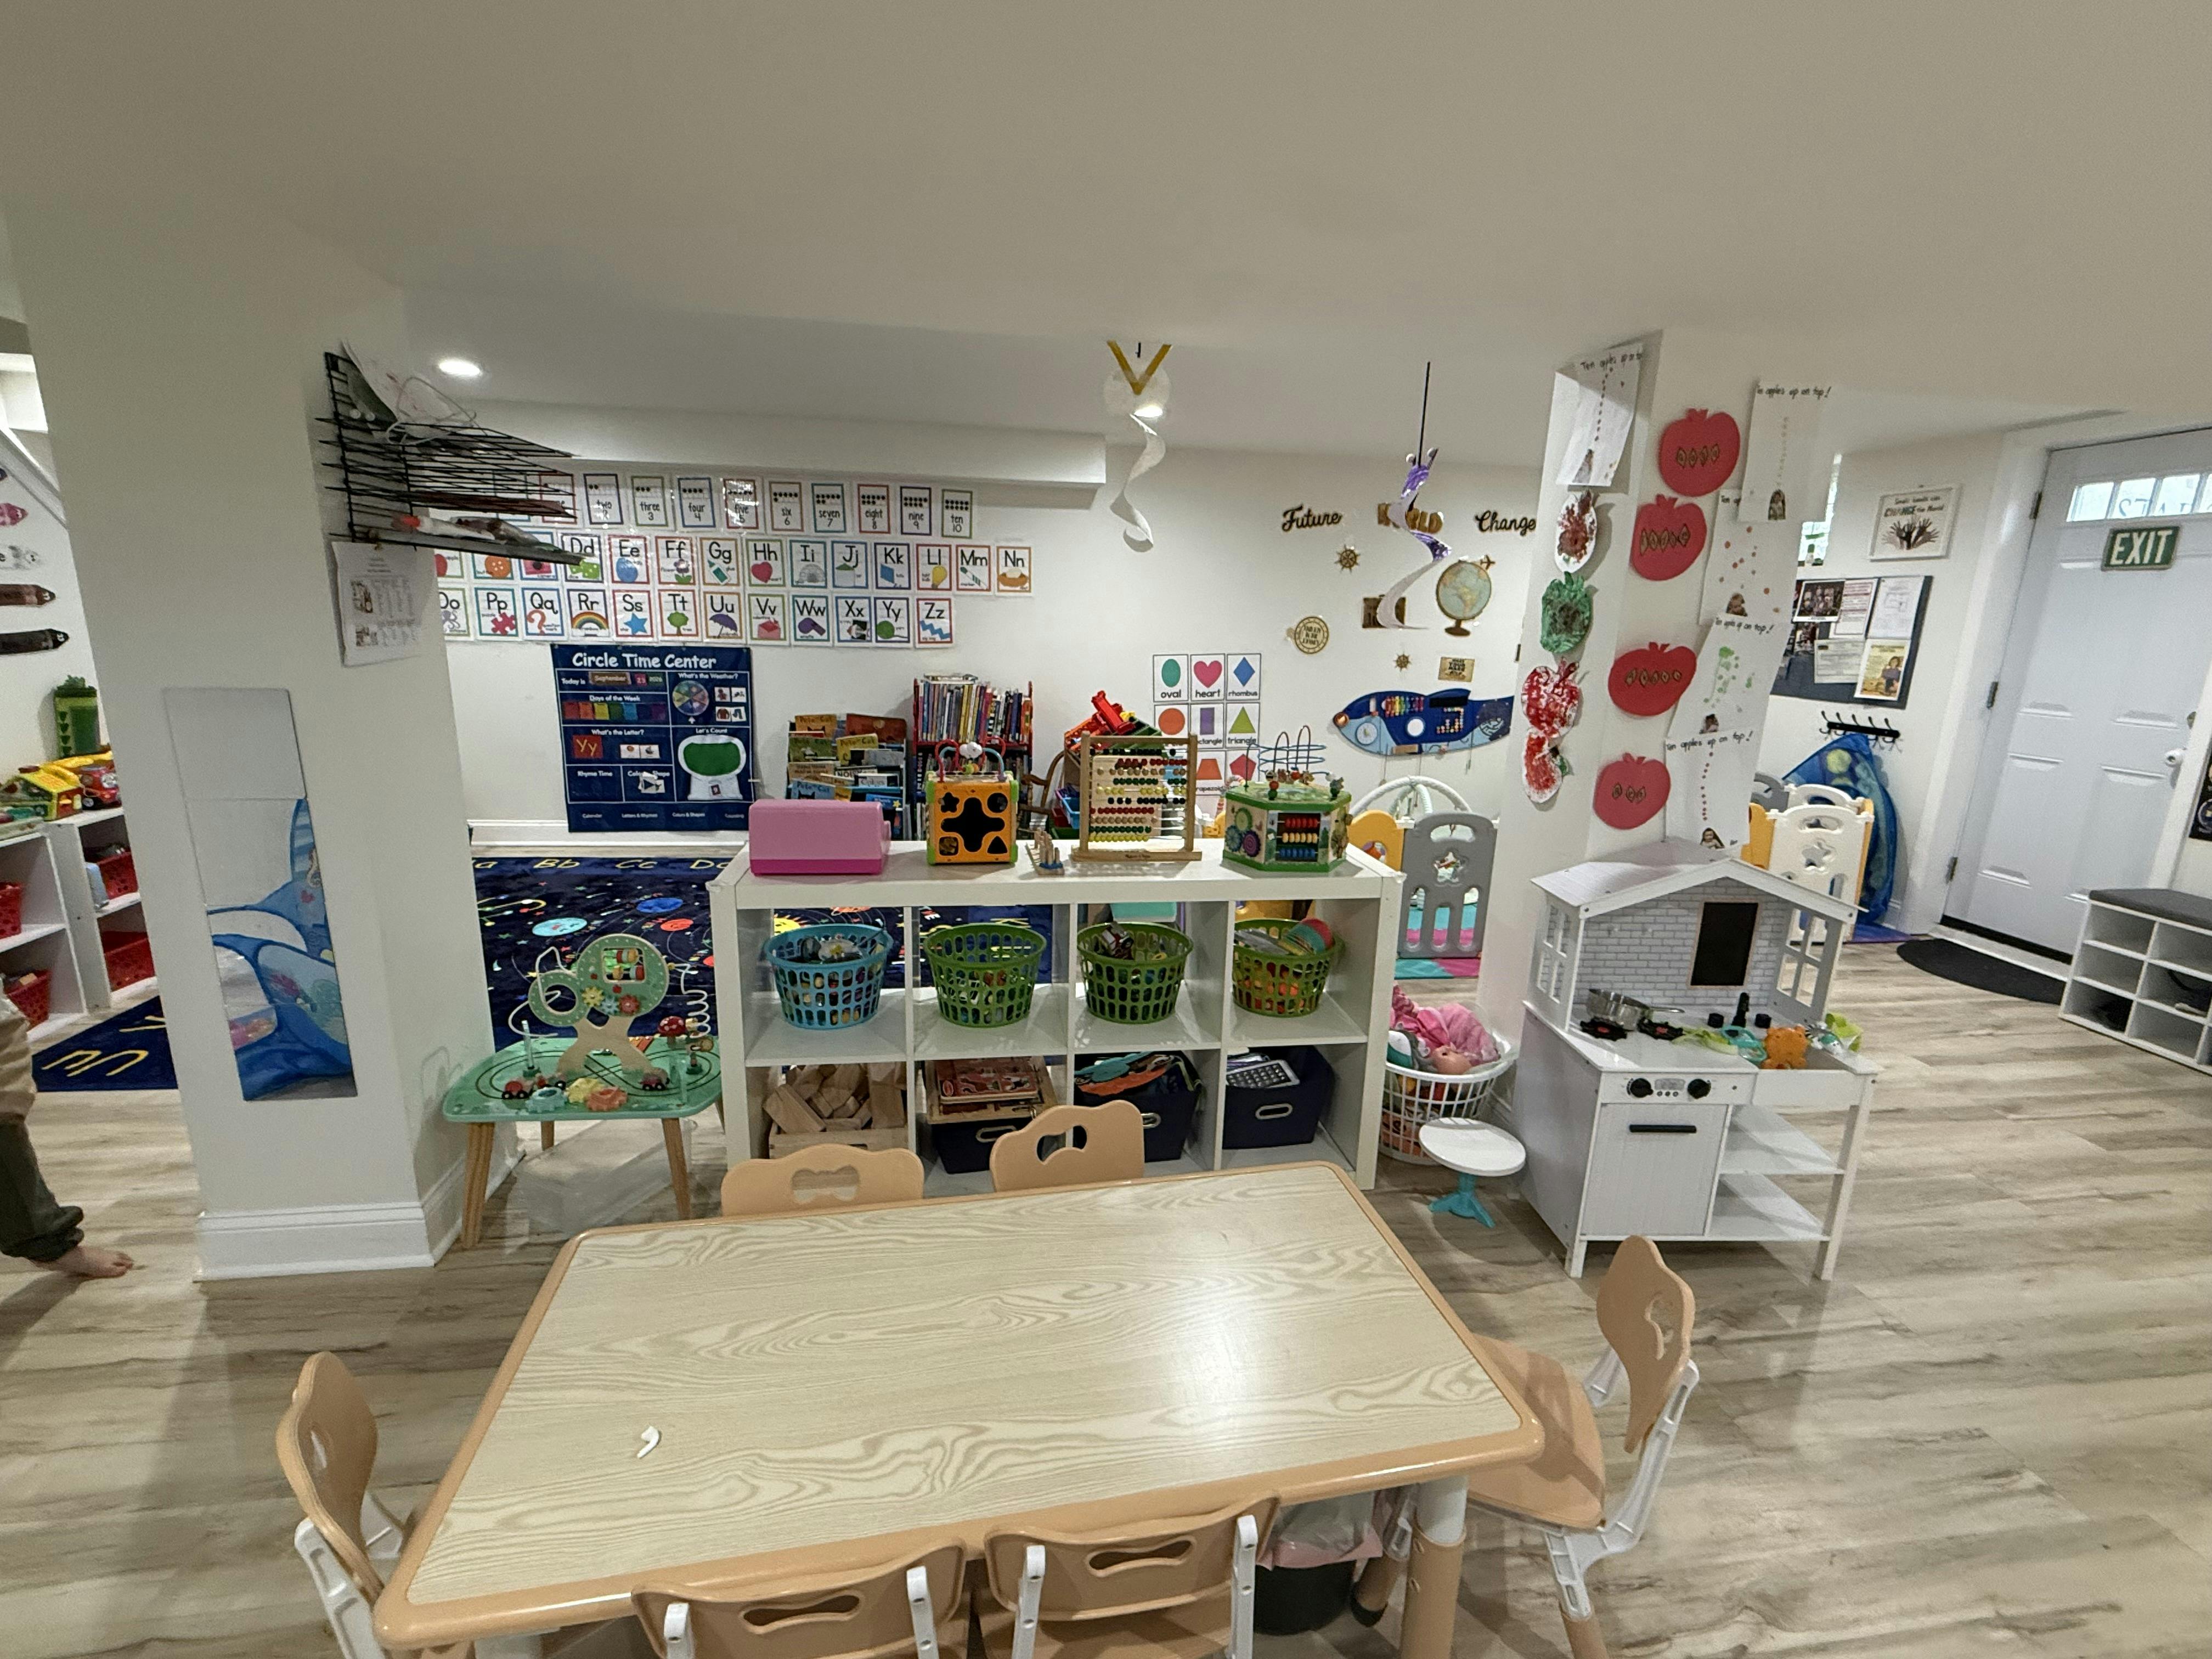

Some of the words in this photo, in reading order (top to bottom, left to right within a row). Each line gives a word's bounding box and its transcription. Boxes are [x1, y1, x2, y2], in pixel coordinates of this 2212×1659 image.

[640, 501, 661, 511] three
[688, 502, 705, 512] four
[734, 504, 749, 515] five
[781, 506, 792, 517] six
[819, 509, 840, 518] seven
[865, 509, 883, 521] eight
[648, 512, 654, 521] 3
[695, 514, 702, 522] 4
[740, 515, 746, 523] 5
[784, 517, 791, 526] 6
[827, 518, 833, 527] 7
[872, 521, 877, 530] 8
[909, 512, 924, 521] nine
[913, 521, 919, 530] 9
[950, 514, 963, 524] ten
[1282, 503, 1344, 532] Future
[1475, 509, 1536, 537] Change
[952, 524, 962, 533] 10
[571, 537, 594, 555] Dd
[619, 539, 641, 558] Ee
[665, 540, 686, 558] Ff
[709, 541, 732, 564] Gg
[753, 543, 778, 561] Hh
[800, 544, 815, 562] Ii
[2109, 529, 2173, 566] EXIT
[842, 545, 859, 569] Jj
[884, 546, 904, 565] Kk
[927, 548, 941, 566] Ll
[961, 549, 988, 567] Mm
[1004, 550, 1025, 568] Nn
[487, 592, 508, 614] Pp
[530, 592, 558, 615] Qq
[578, 592, 600, 611] Rr
[622, 594, 644, 612] Ss
[668, 594, 688, 611] Tt
[710, 595, 735, 614] Uu
[756, 597, 777, 616] Vv
[795, 599, 826, 617] Ww
[844, 600, 865, 618] Xx
[882, 601, 901, 623] Yy
[924, 602, 945, 620] Zz
[572, 652, 619, 668] Circle
[622, 653, 662, 668] Time
[664, 653, 717, 669] Center
[561, 678, 580, 686] Today
[1160, 689, 1182, 698] oval
[1195, 689, 1221, 698] heart
[576, 738, 597, 757] Yy
[1227, 737, 1257, 746] triangle
[533, 859, 580, 869] Bb
[615, 859, 658, 869] Cc
